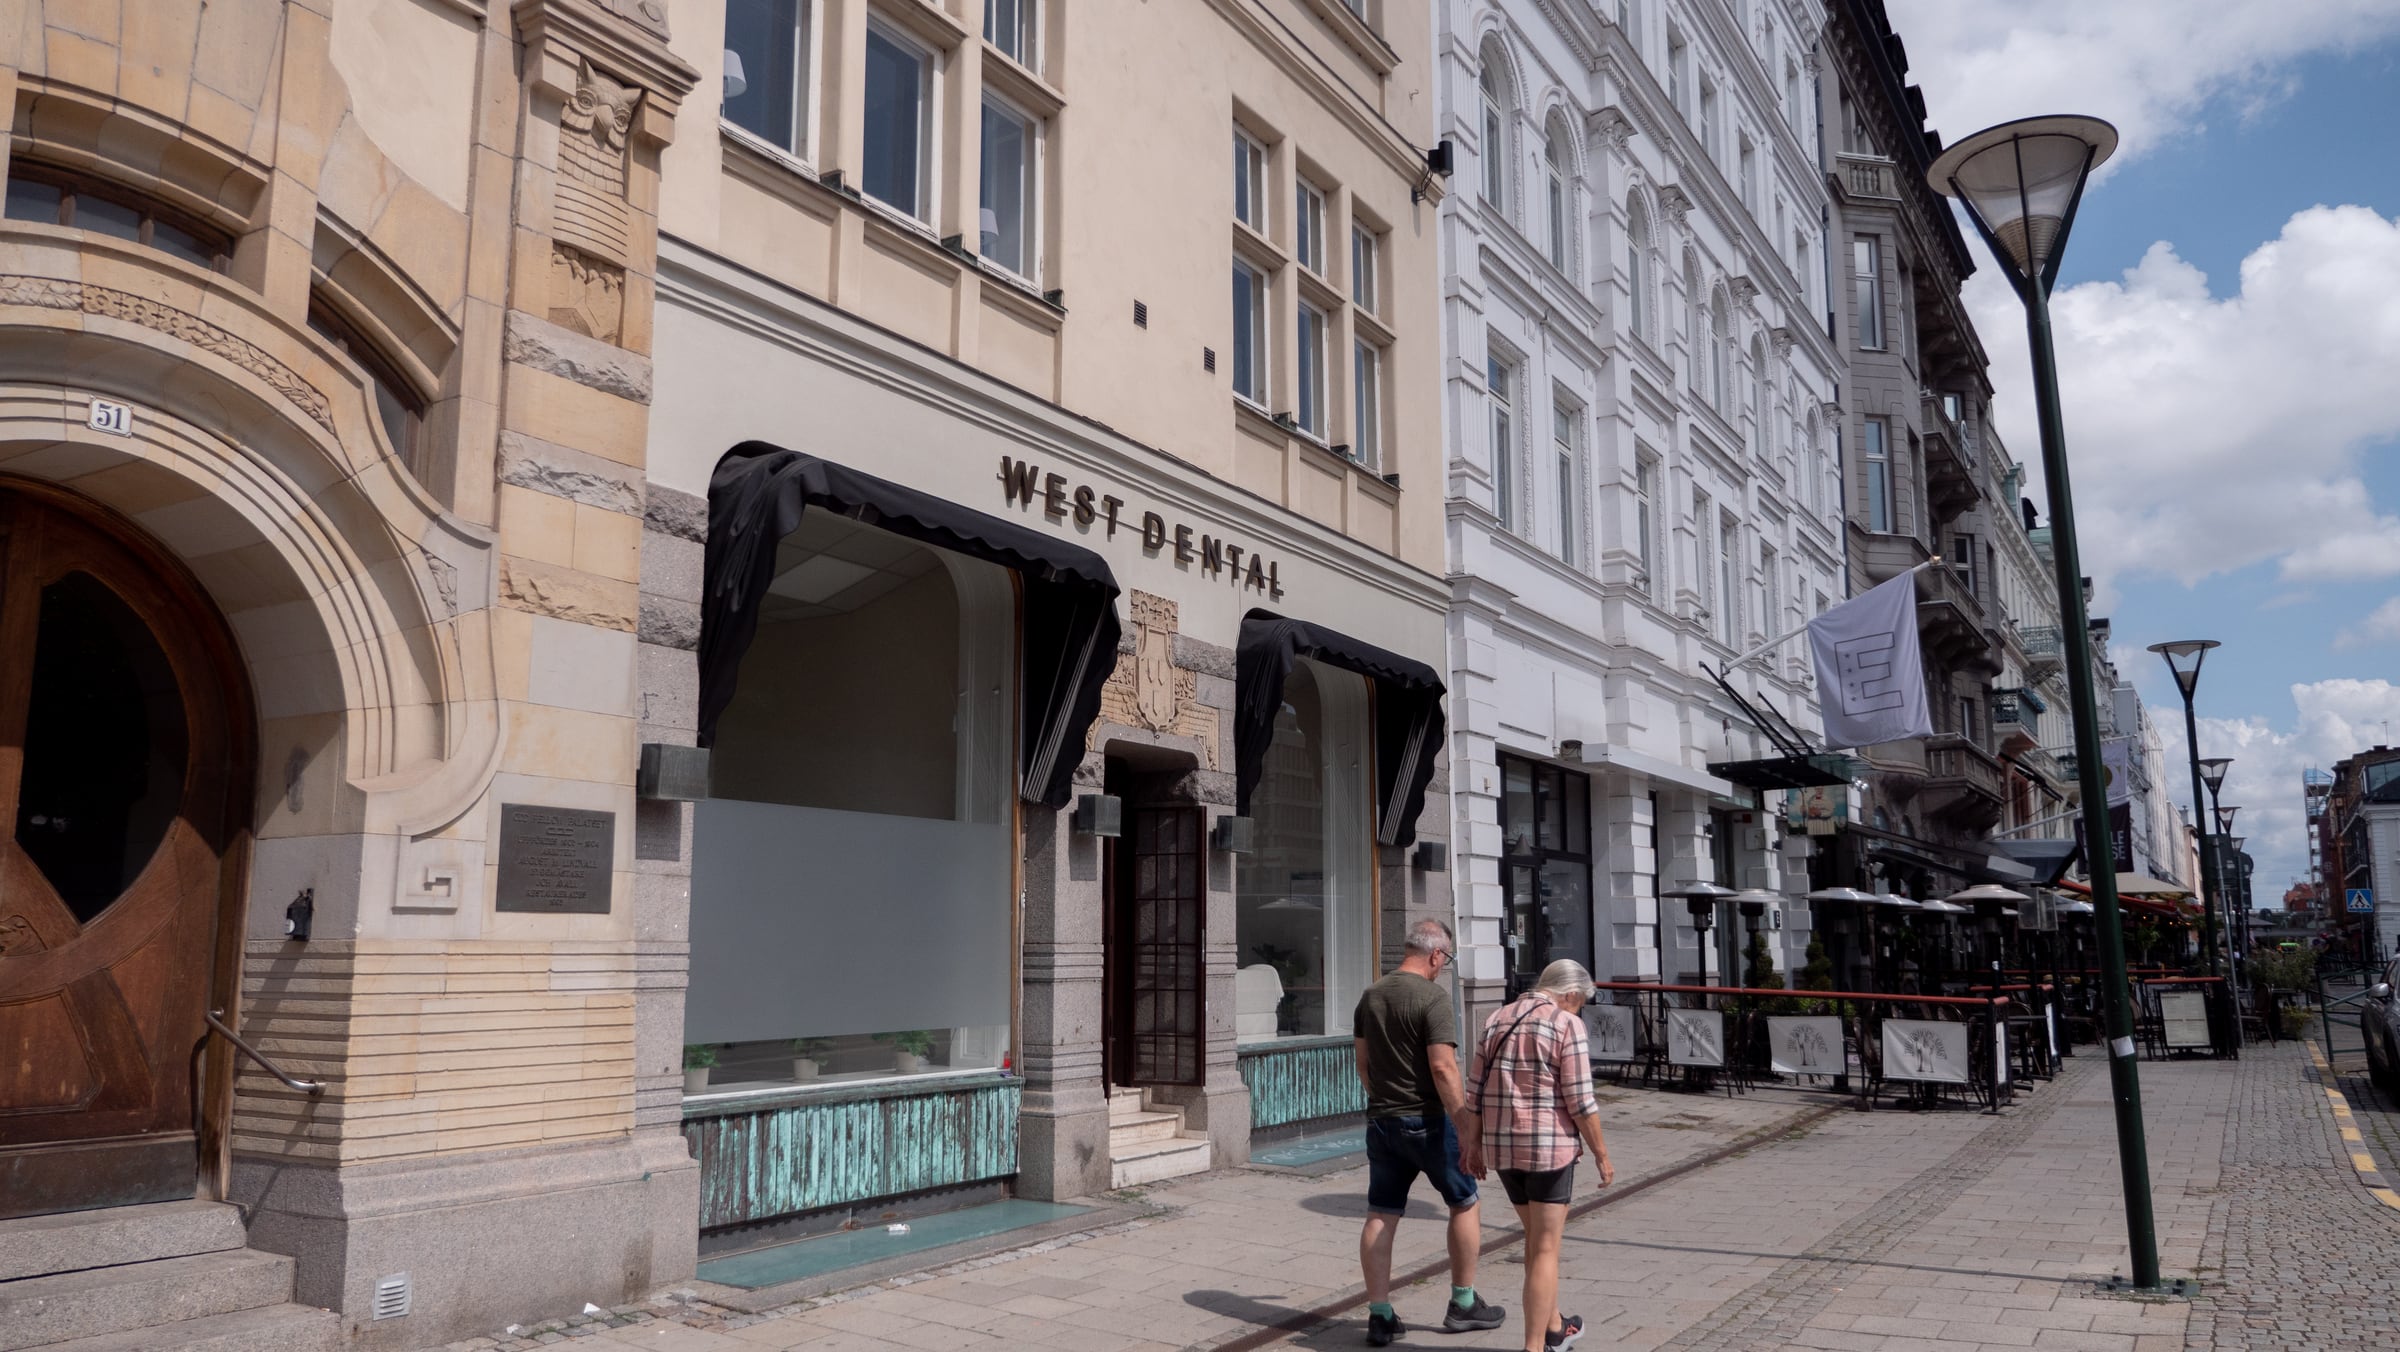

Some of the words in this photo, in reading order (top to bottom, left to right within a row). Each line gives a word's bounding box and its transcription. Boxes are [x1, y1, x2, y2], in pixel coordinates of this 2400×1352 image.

[97, 403, 122, 431] 51
[1002, 455, 1124, 535] WEST
[1144, 510, 1285, 597] DENTAL
